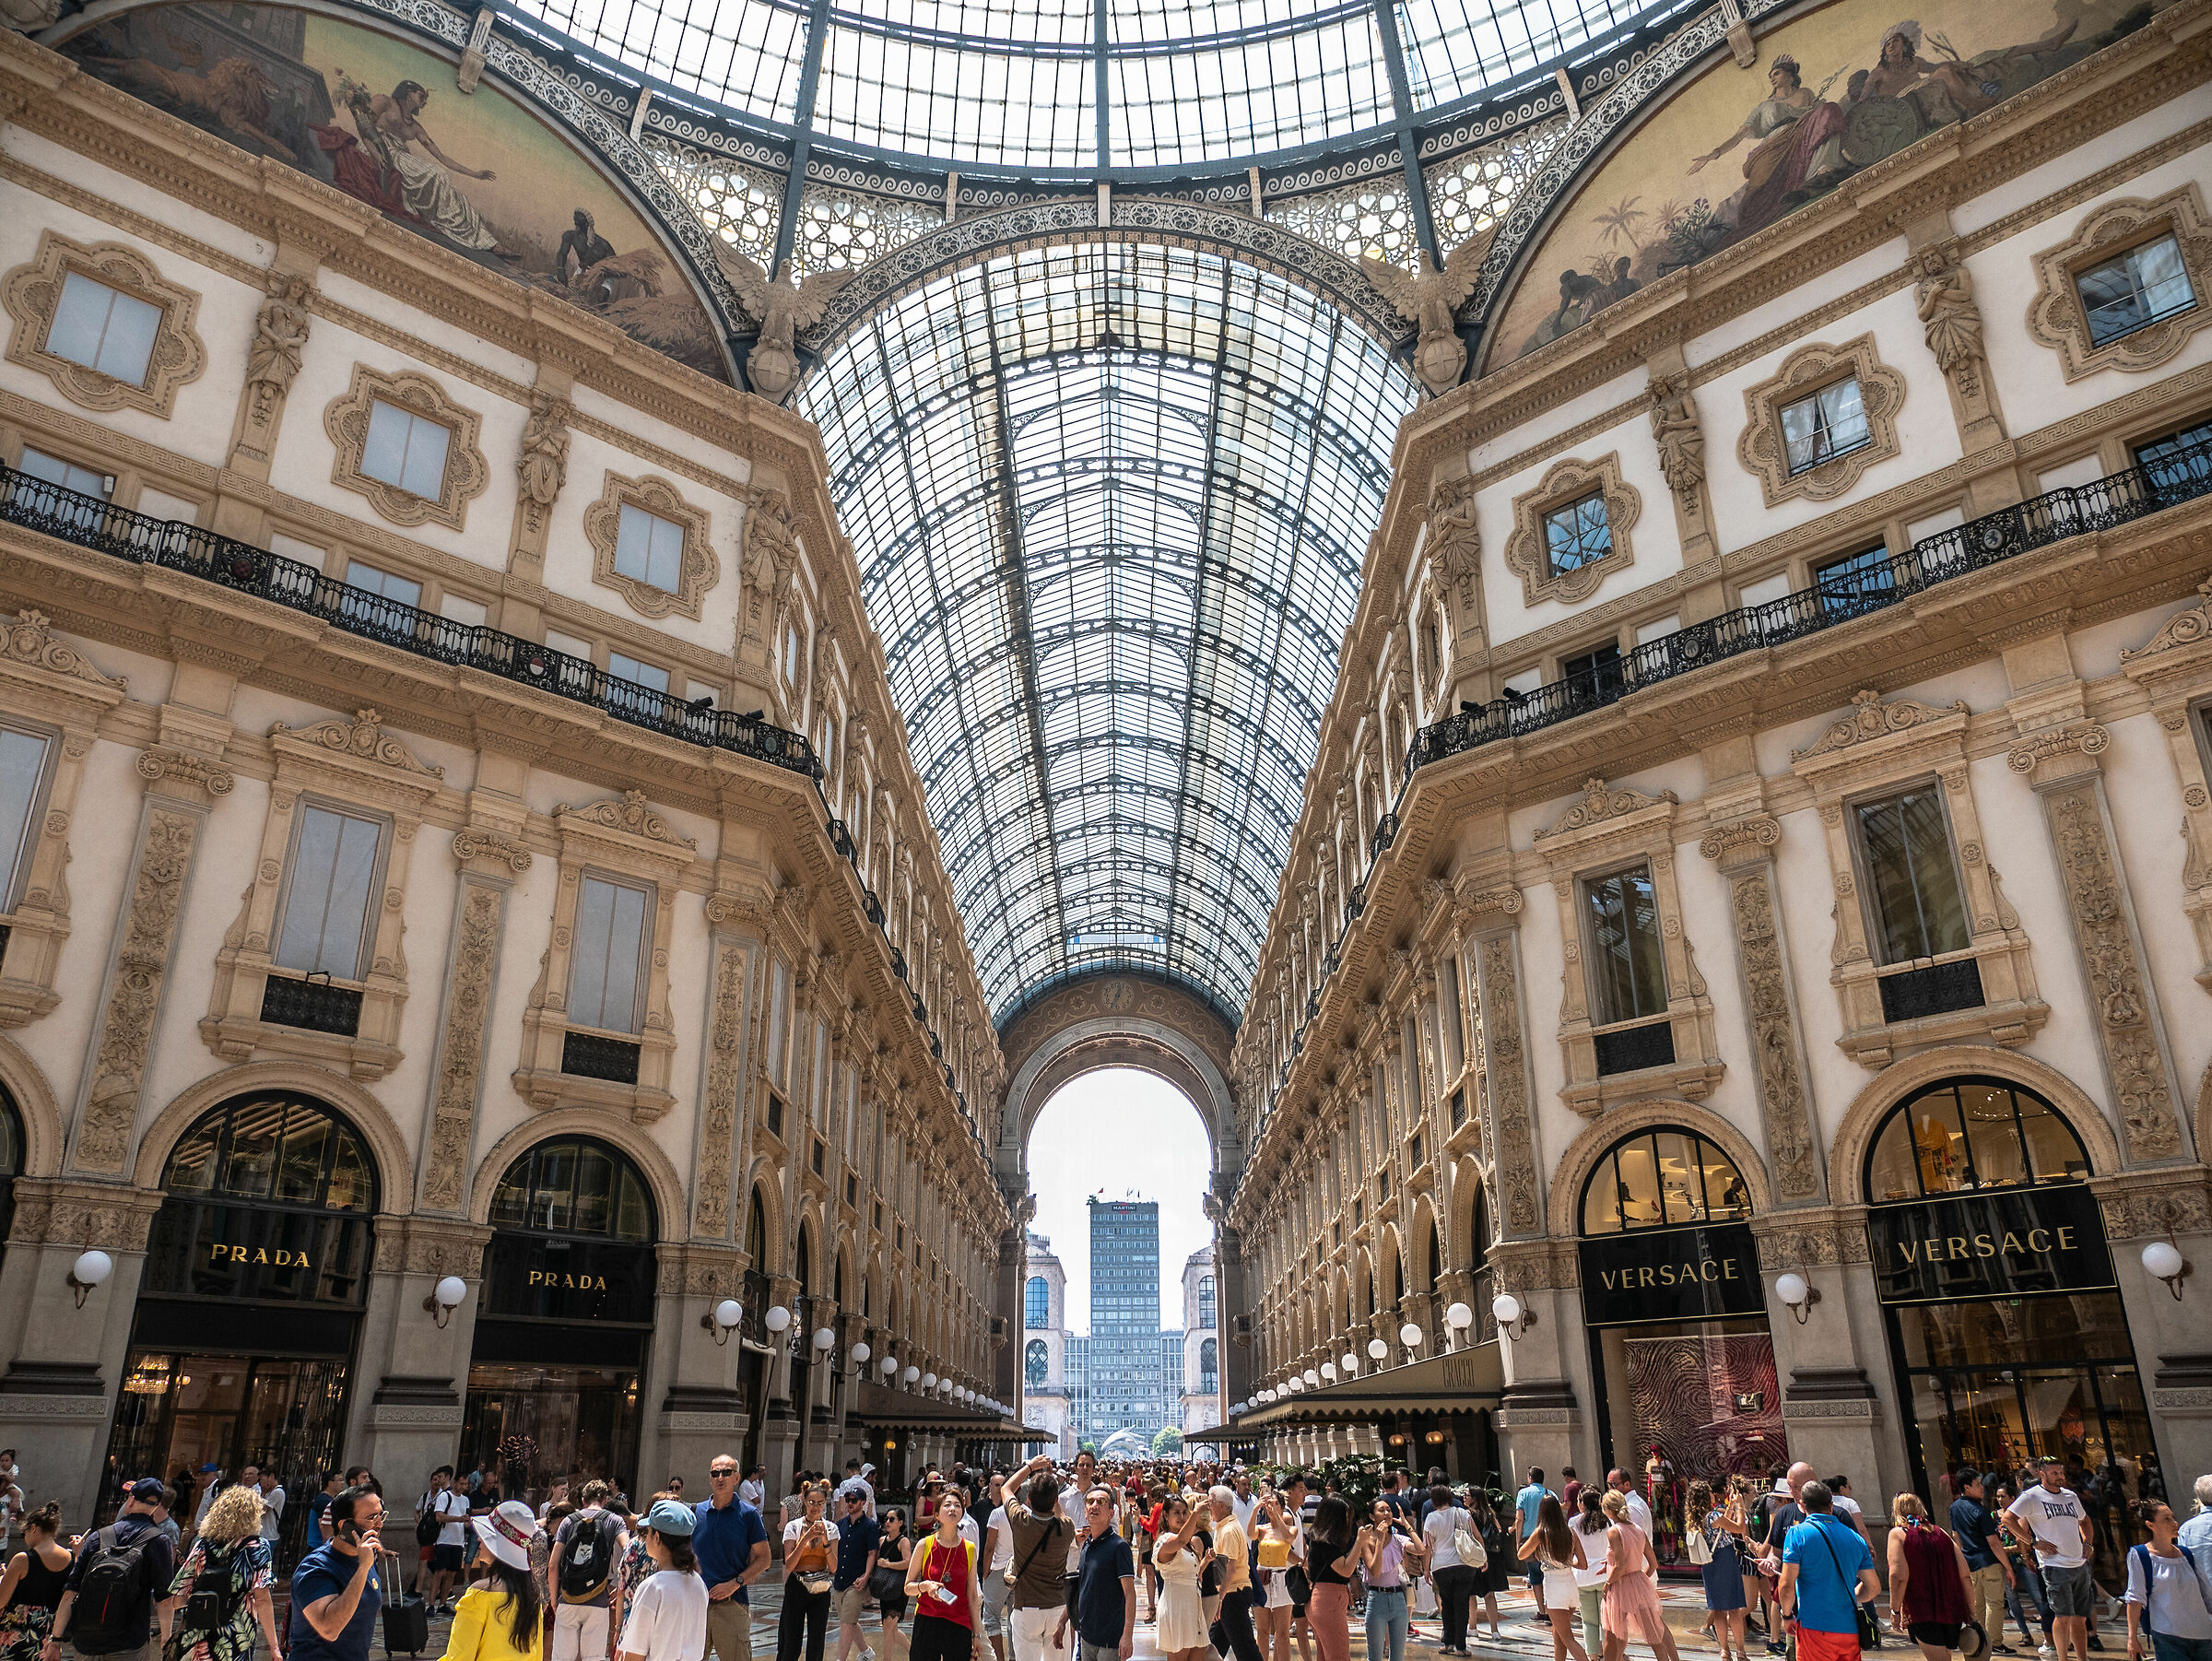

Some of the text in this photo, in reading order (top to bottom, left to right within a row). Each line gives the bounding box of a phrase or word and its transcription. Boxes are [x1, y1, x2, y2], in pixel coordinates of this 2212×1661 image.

[210, 1243, 311, 1267] PRADA
[1898, 1226, 2078, 1264] VERSACE
[528, 1270, 607, 1290] PRADA
[1600, 1258, 1739, 1290] VERSACE
